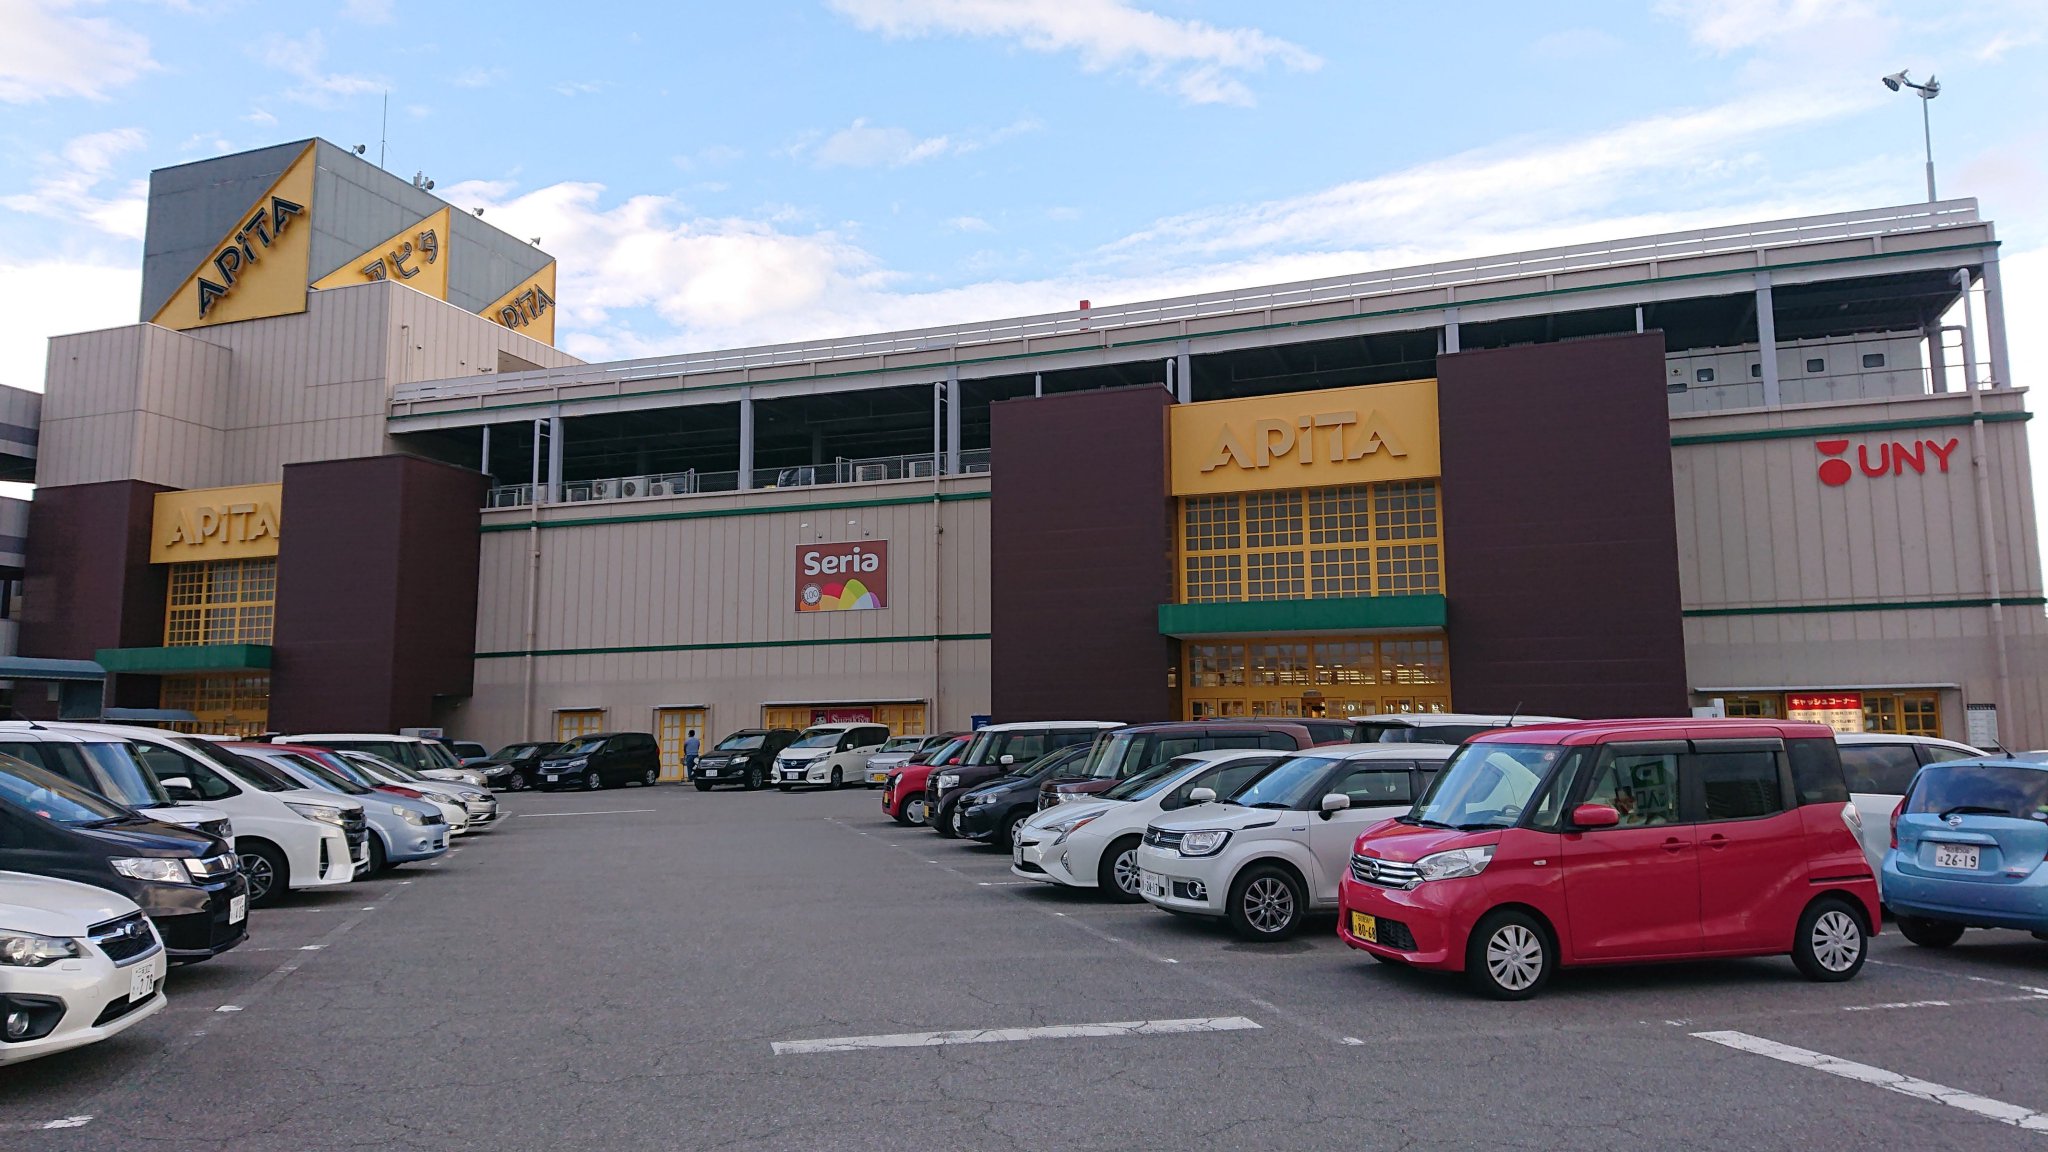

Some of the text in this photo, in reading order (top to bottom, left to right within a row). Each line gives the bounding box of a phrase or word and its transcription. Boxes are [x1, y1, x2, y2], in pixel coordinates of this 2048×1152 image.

[1858, 438, 1959, 478] UNY
[804, 546, 879, 576] Seria
[1792, 697, 1857, 707] キャッシュコーナー
[1944, 853, 1977, 868] 26-19
[1358, 922, 1376, 940] 80-68
